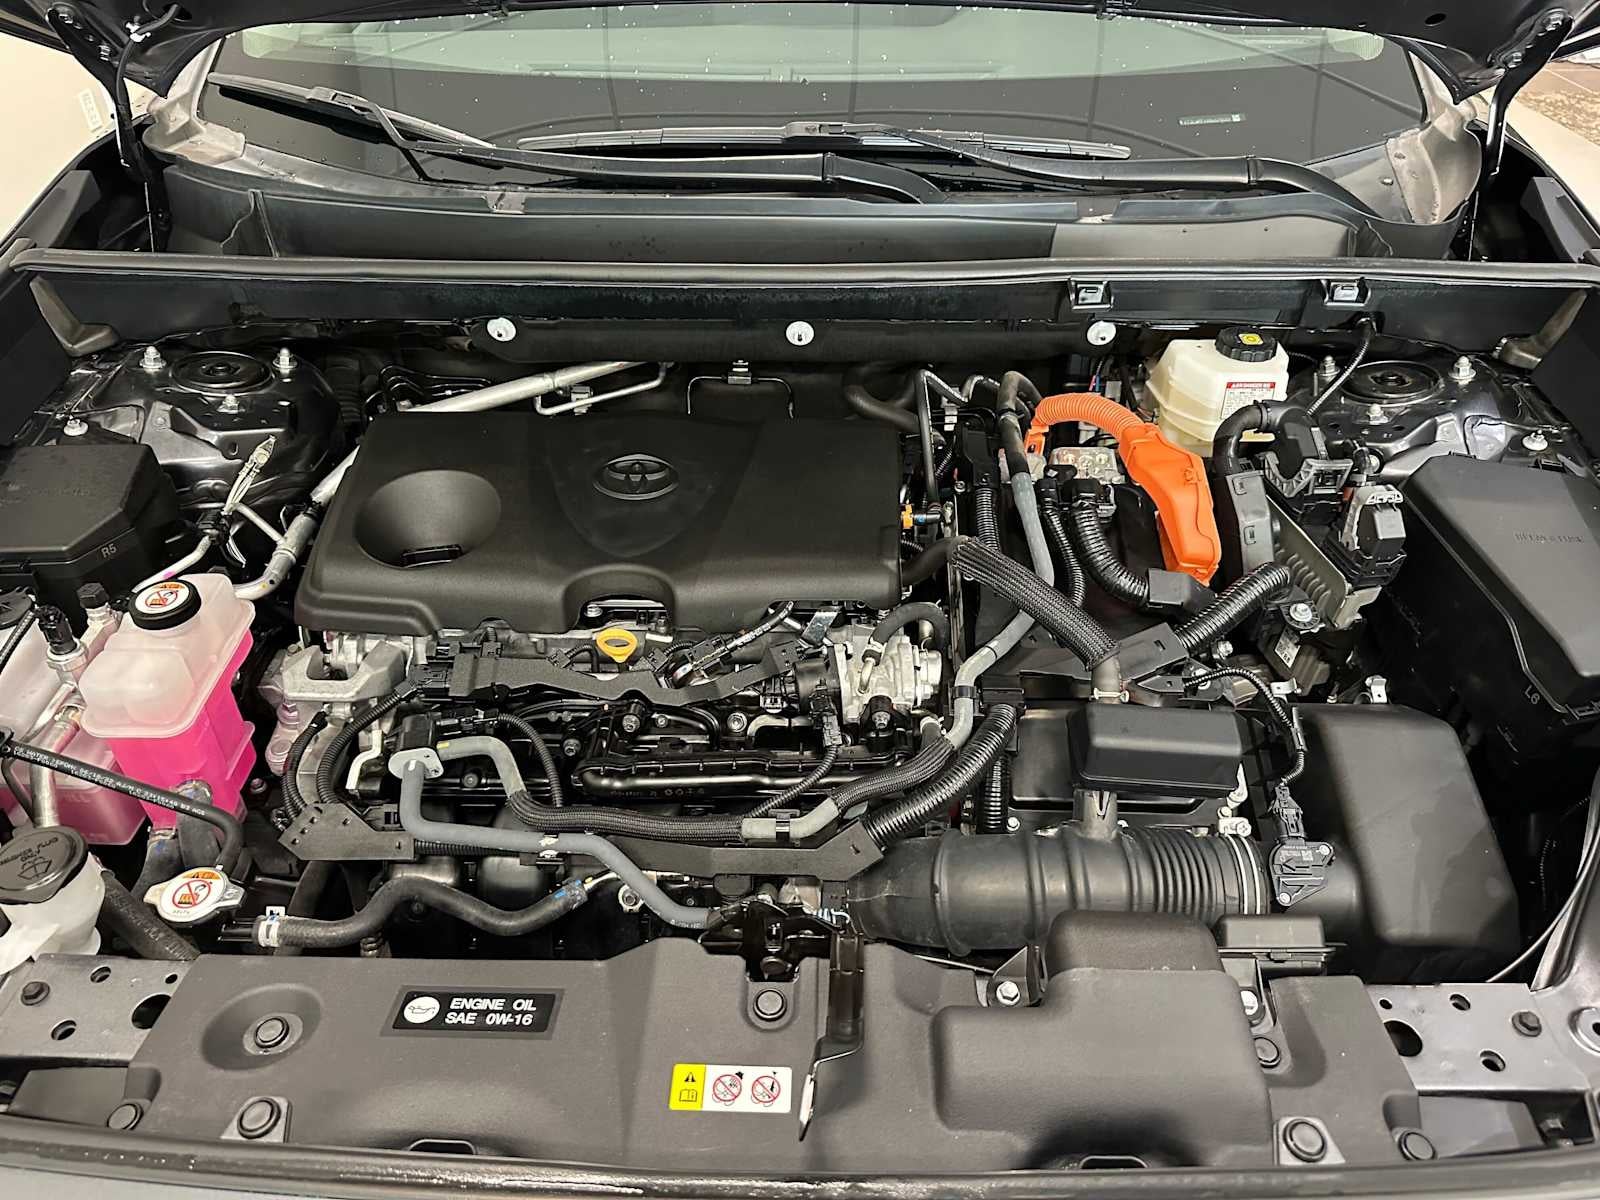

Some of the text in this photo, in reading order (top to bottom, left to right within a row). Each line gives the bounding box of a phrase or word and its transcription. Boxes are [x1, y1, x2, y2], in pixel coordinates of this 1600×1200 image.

[101, 543, 117, 558] R5
[1524, 684, 1540, 704] L6
[449, 997, 537, 1011] ENGINE OIL
[444, 1011, 534, 1026] SAE 0W-16
